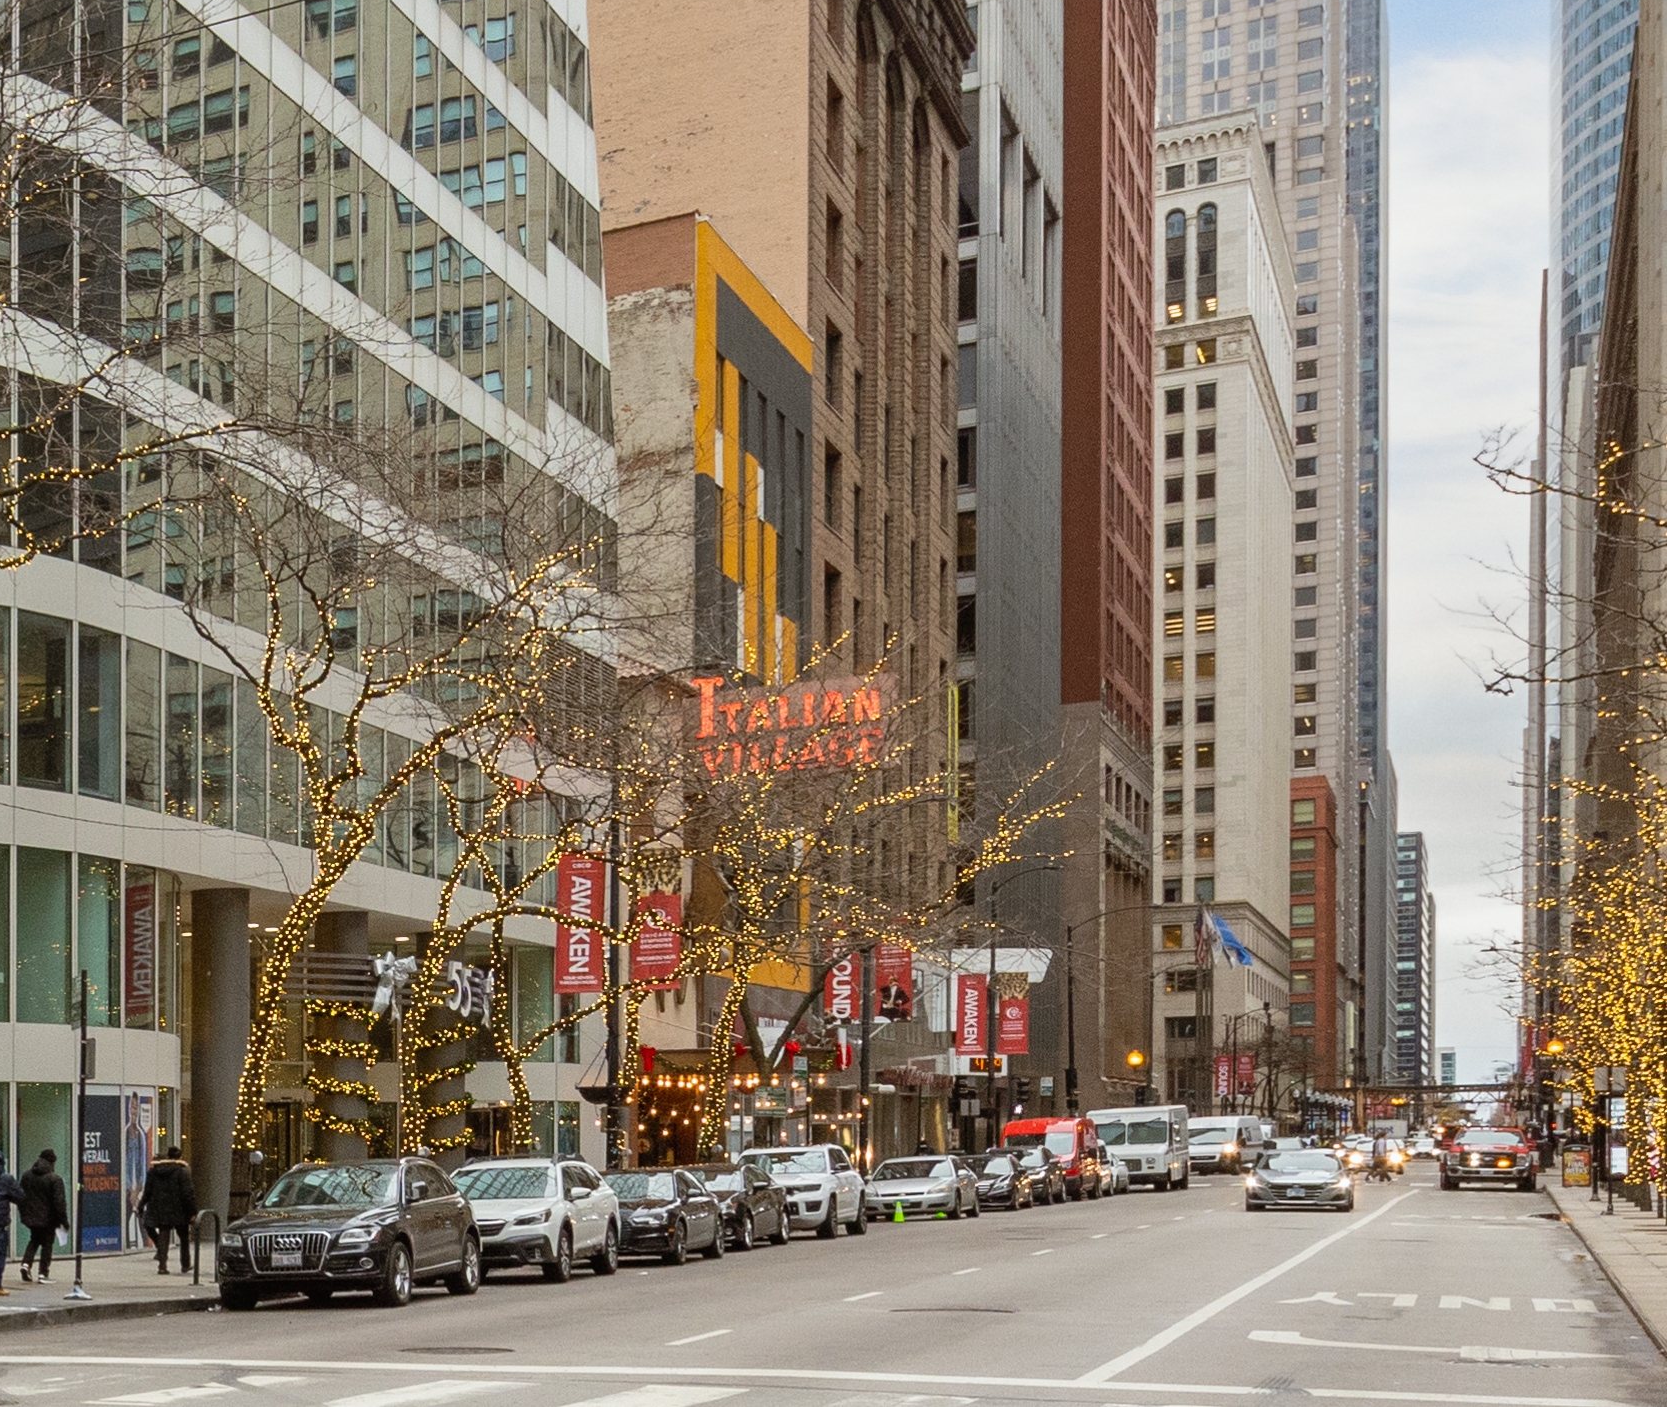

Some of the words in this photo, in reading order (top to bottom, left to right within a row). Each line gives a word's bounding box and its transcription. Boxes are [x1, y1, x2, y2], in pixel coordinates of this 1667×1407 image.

[691, 676, 881, 739] ITALIAN
[696, 728, 883, 777] VILLAGE
[963, 988, 979, 1045] AWAKEN
[82, 1149, 111, 1163] VERALL
[84, 1131, 102, 1148] EST
[1275, 1291, 1600, 1314] ONLY
